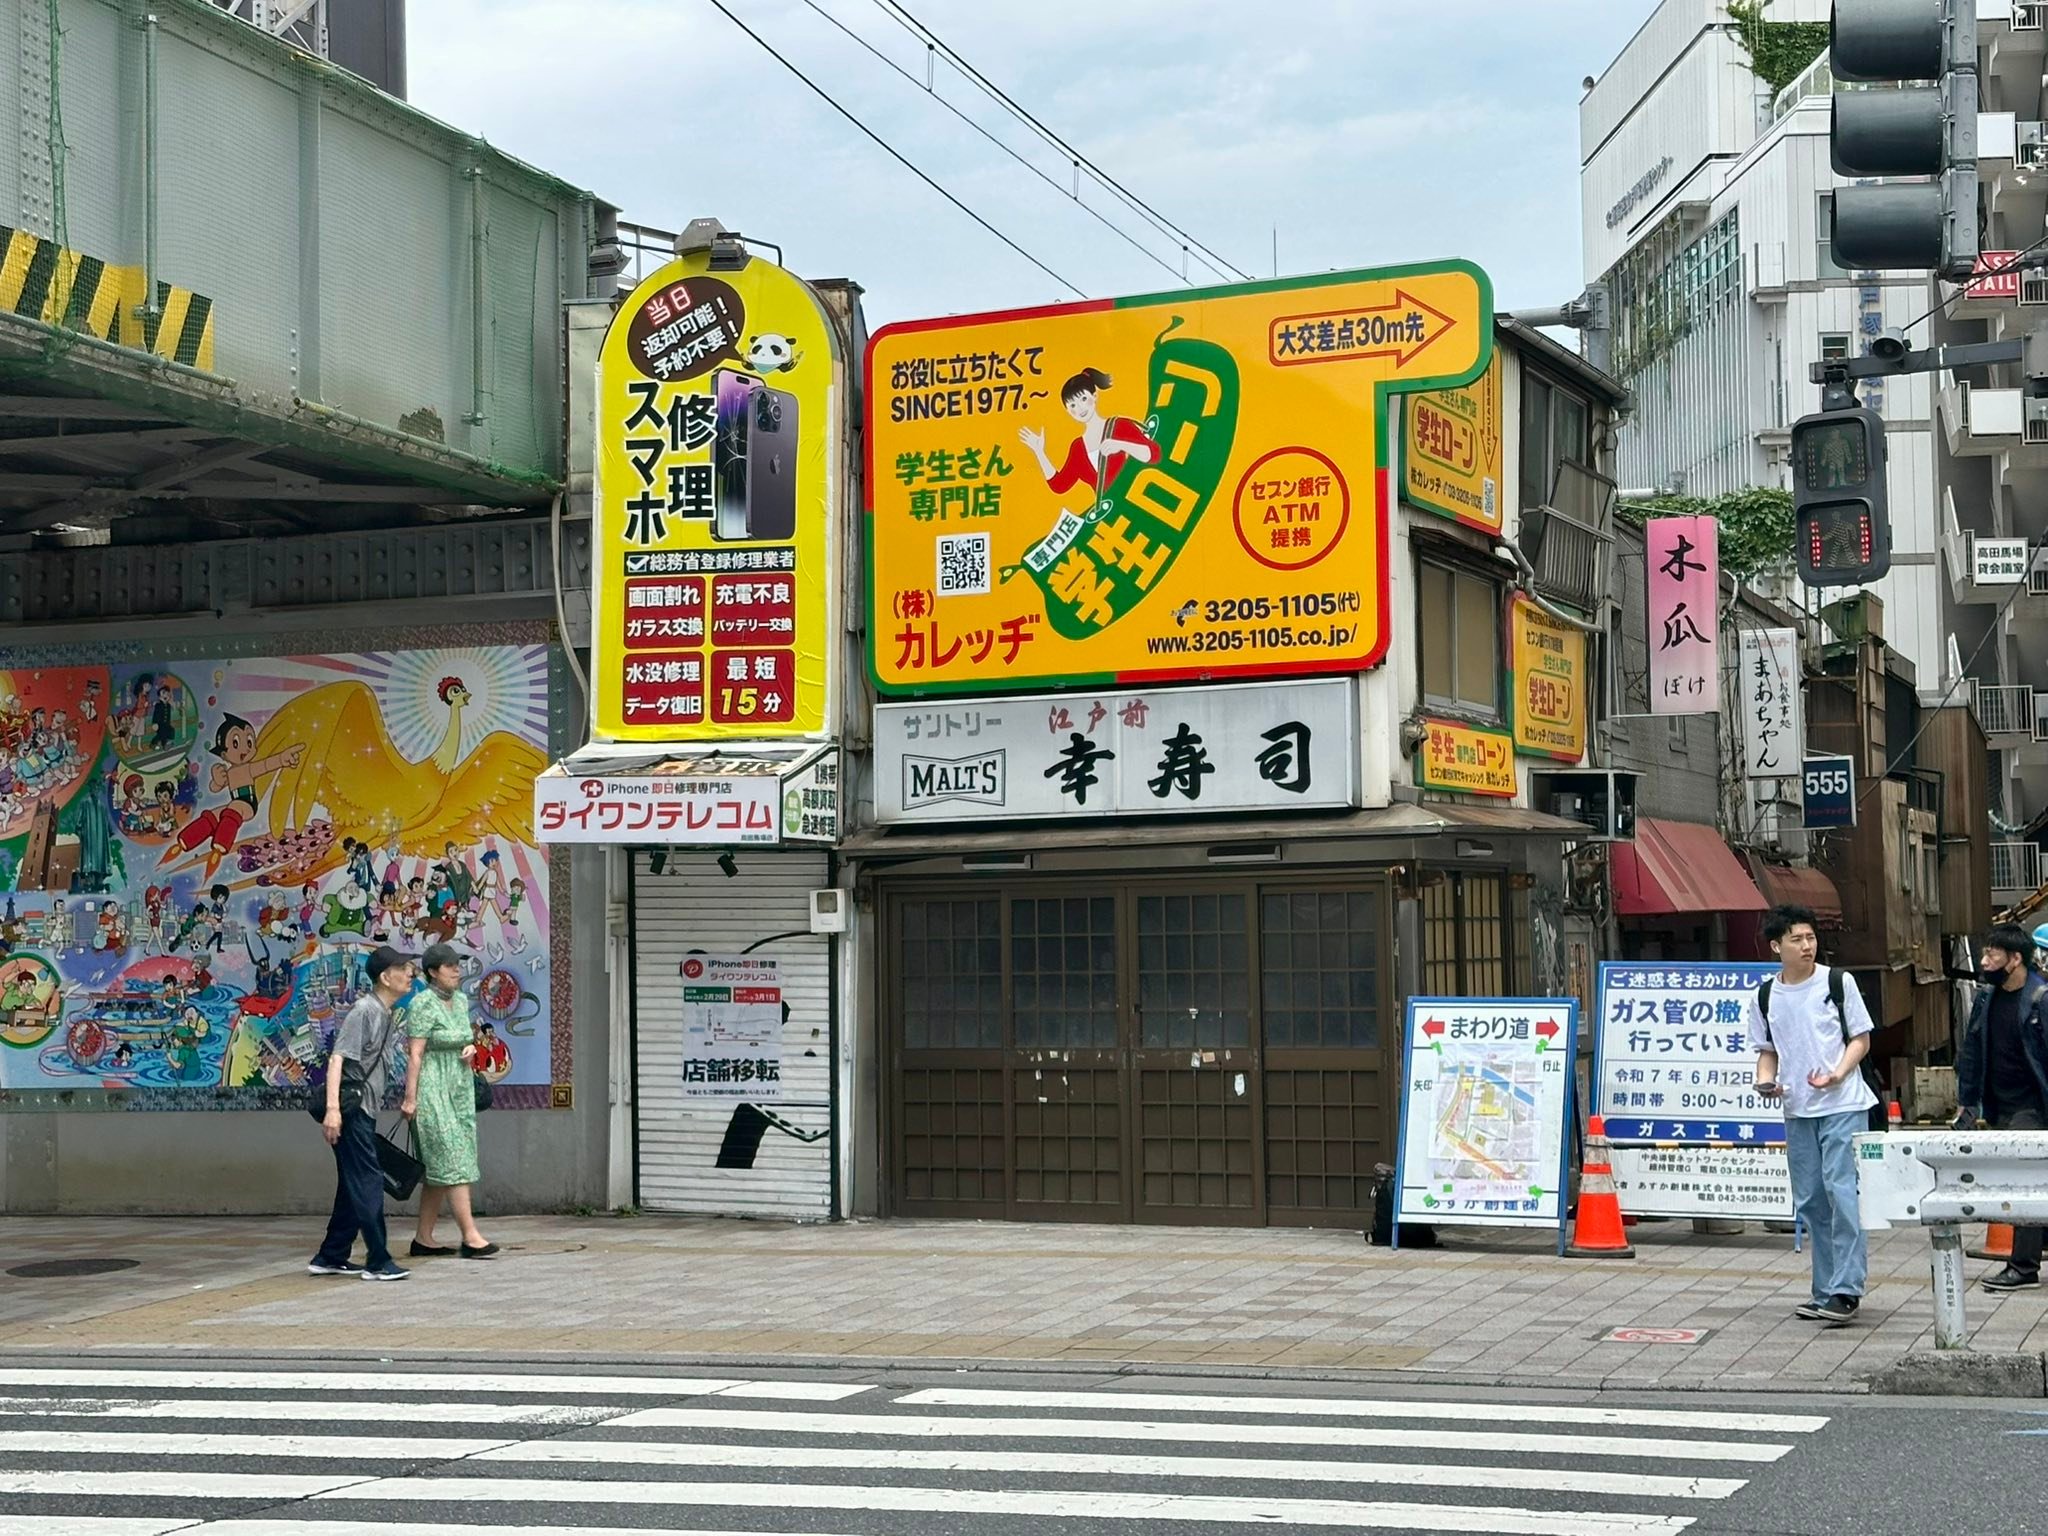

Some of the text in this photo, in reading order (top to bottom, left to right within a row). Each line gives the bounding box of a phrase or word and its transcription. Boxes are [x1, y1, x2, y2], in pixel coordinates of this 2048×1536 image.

[646, 286, 691, 326] 当日
[1276, 311, 1426, 357] 大交差点30m先
[891, 346, 1044, 391] お役に立ちたくて
[1417, 405, 1474, 469] 学生ローン
[624, 381, 667, 545] スマホ
[667, 394, 718, 520] 修理
[895, 444, 1014, 486] 学生さん
[909, 483, 1002, 521] 専門店
[1263, 502, 1320, 524] ATM
[1031, 514, 1079, 568] 専門店
[1271, 526, 1312, 548] 提携
[649, 551, 795, 572] 総務省登録修理業者
[628, 585, 701, 608] 画面割れ
[715, 582, 791, 605] 充電不良
[1659, 534, 1711, 652] 木瓜
[627, 618, 703, 638] ガラス交換
[713, 617, 793, 633] バッテリー交換
[894, 613, 1041, 670] カレッヂ
[1147, 622, 1358, 655] www.3205-1105.co.jp/
[625, 660, 700, 684] 水没修理
[726, 656, 776, 681] 最短
[1529, 676, 1571, 720] 学生ローン
[1664, 674, 1706, 698] ぼけ
[625, 696, 703, 716] データ復旧
[1047, 698, 1150, 735] 江戸前
[903, 711, 1002, 740] サントリー
[607, 782, 732, 794] iPhone 即日修理専門店
[911, 759, 997, 798] MALT'S
[1805, 770, 1849, 796] 555
[540, 800, 773, 831] ダイワンテレコム
[1610, 997, 1750, 1025] ガス管の撤
[1450, 1015, 1531, 1040] まわり道
[1628, 1030, 1757, 1053] 行っていま
[682, 1058, 780, 1083] 店舗移転
[1413, 1079, 1433, 1092] 矢印
[1612, 1092, 1665, 1107] 時間帯
[1638, 1122, 1755, 1140] ガス工事
